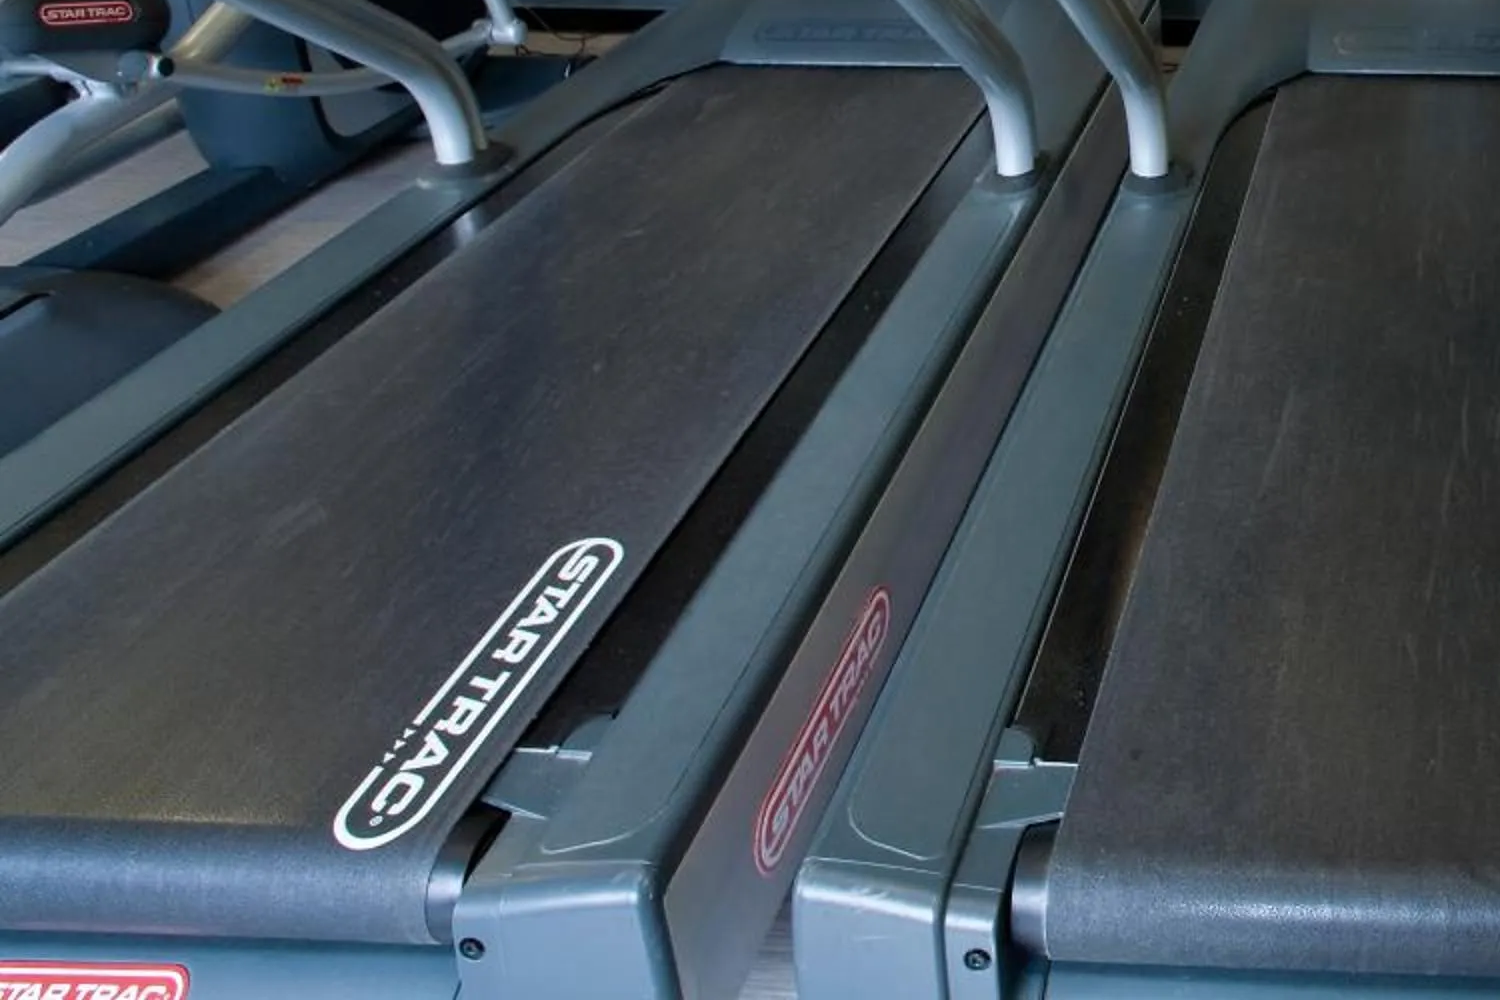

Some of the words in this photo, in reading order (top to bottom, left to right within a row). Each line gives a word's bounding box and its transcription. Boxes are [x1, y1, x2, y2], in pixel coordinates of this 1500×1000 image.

[48, 8, 86, 19] STAR
[87, 6, 126, 17] TRAC
[492, 551, 600, 665] STAR
[370, 671, 507, 817] TRAC
[772, 716, 829, 834] STAR
[829, 612, 885, 721] TRAC
